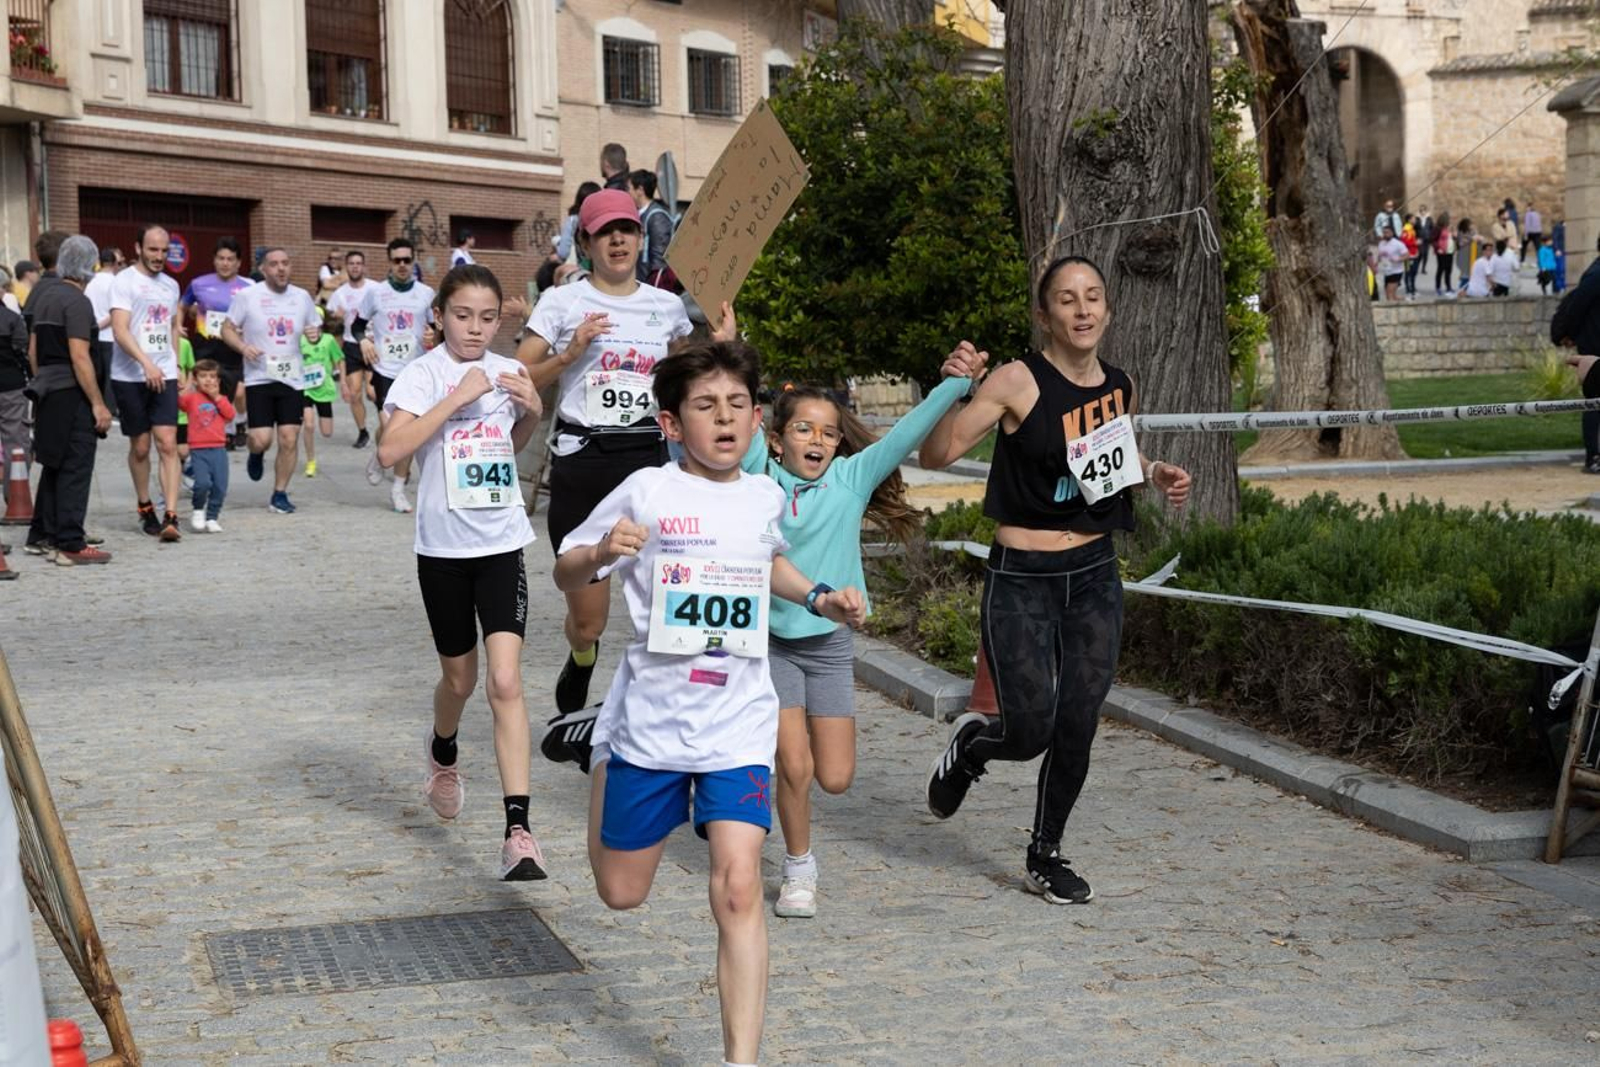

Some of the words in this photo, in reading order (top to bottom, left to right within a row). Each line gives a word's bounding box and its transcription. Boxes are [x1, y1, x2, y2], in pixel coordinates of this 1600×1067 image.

[388, 343, 410, 354] 241
[277, 362, 291, 371] 55
[602, 388, 650, 410] 994
[1327, 413, 1360, 425] DEPORTES
[1467, 404, 1507, 416] DEPORTES
[465, 462, 512, 487] 943
[1081, 446, 1124, 482] 430
[658, 517, 700, 535] XXVII
[674, 593, 752, 629] 408
